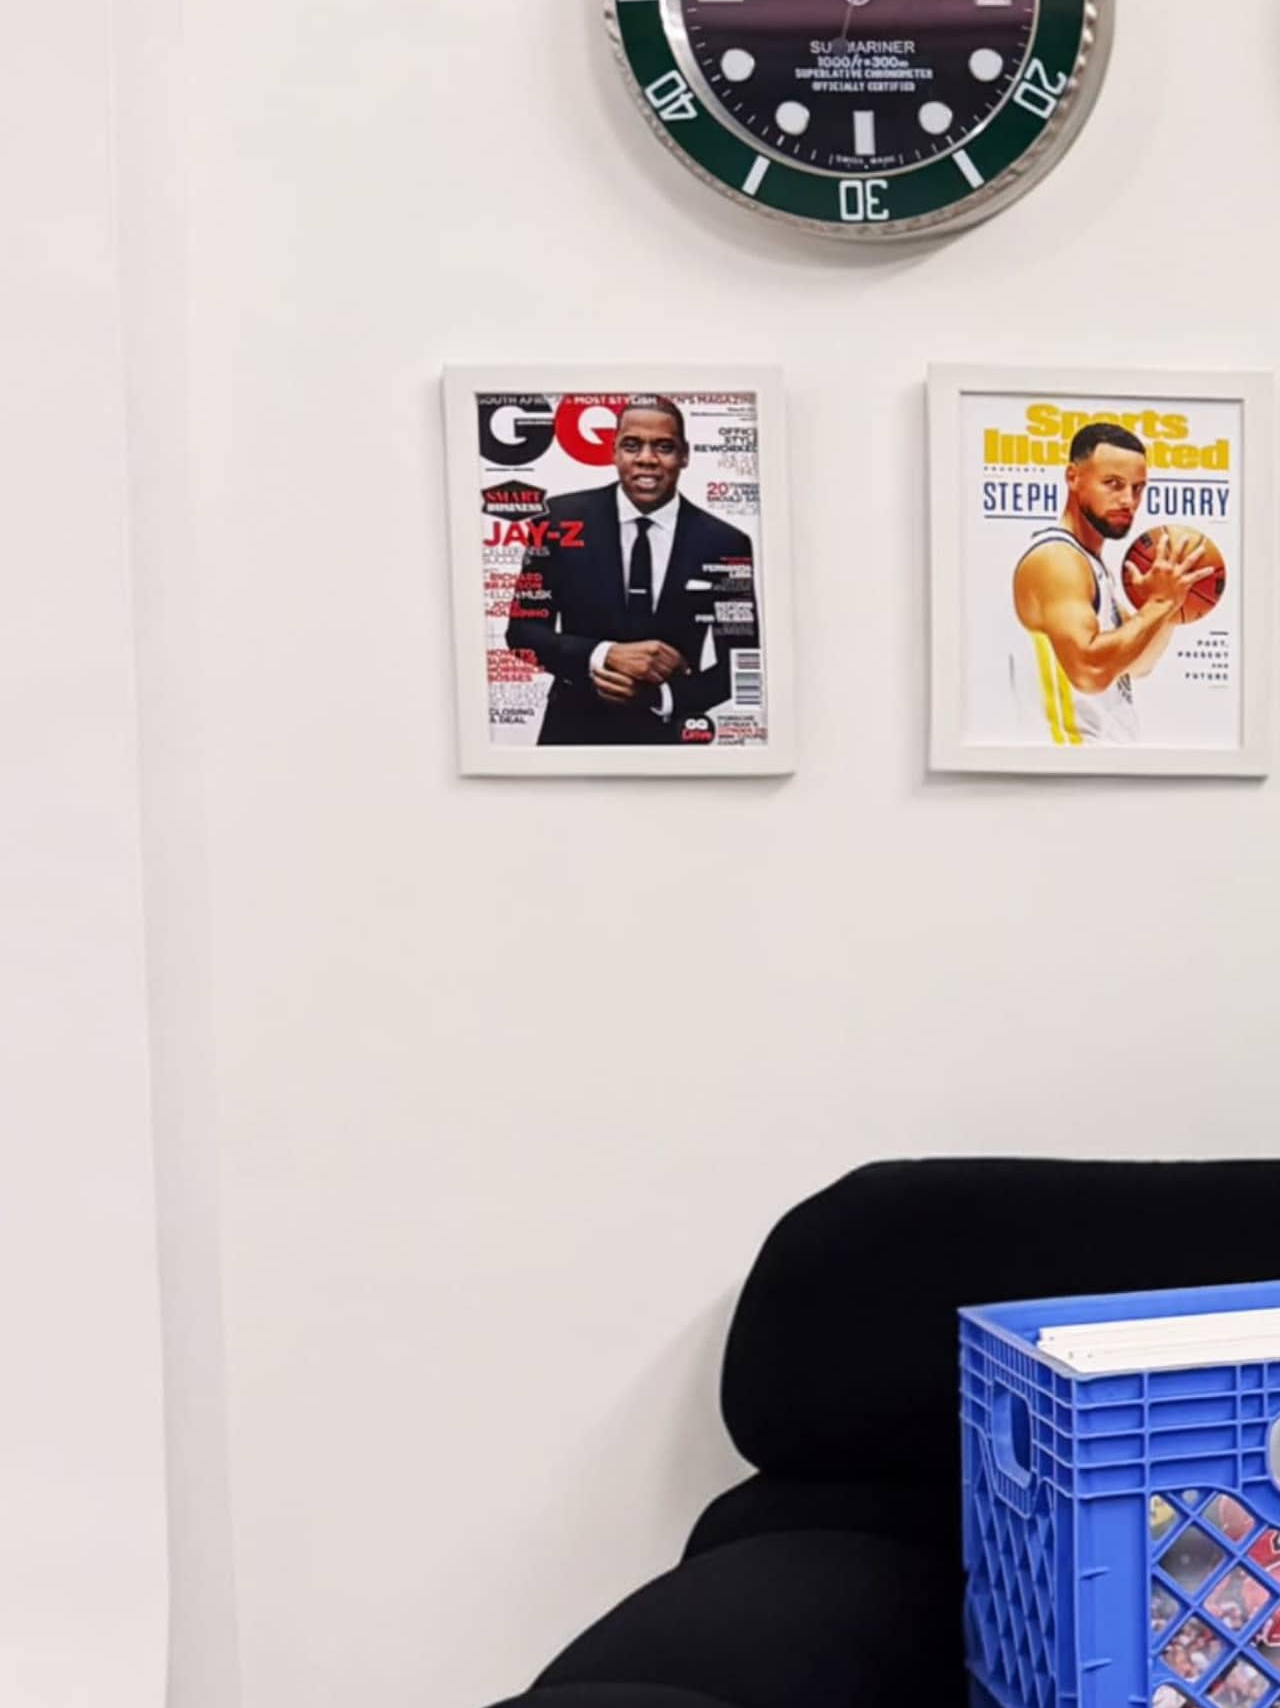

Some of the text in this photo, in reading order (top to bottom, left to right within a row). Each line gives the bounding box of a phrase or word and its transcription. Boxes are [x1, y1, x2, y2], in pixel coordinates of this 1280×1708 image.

[810, 41, 915, 54] SUMARINER
[478, 394, 622, 467] GQ
[486, 492, 540, 502] SMART
[707, 482, 728, 495] 20
[984, 482, 1230, 517] STEPH CURRY
[483, 521, 584, 547] JAY-Z
